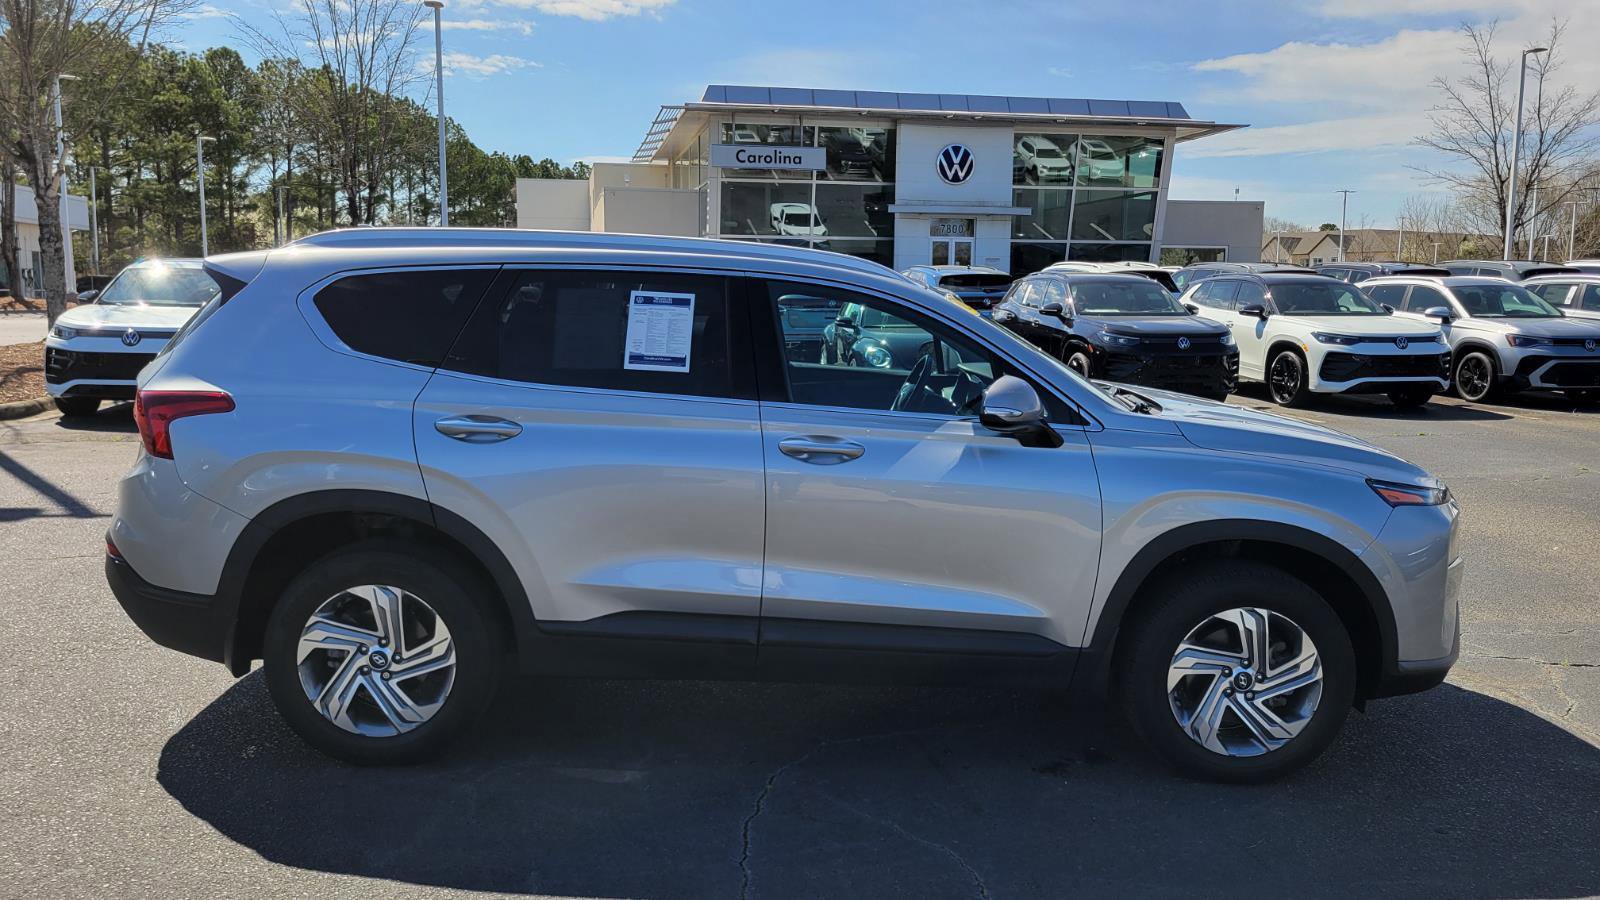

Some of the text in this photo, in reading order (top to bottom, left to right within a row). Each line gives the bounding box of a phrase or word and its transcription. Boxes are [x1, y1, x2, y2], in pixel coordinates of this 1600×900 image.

[735, 149, 803, 166] Carolina
[936, 144, 975, 185] VW
[940, 224, 964, 234] 7800
